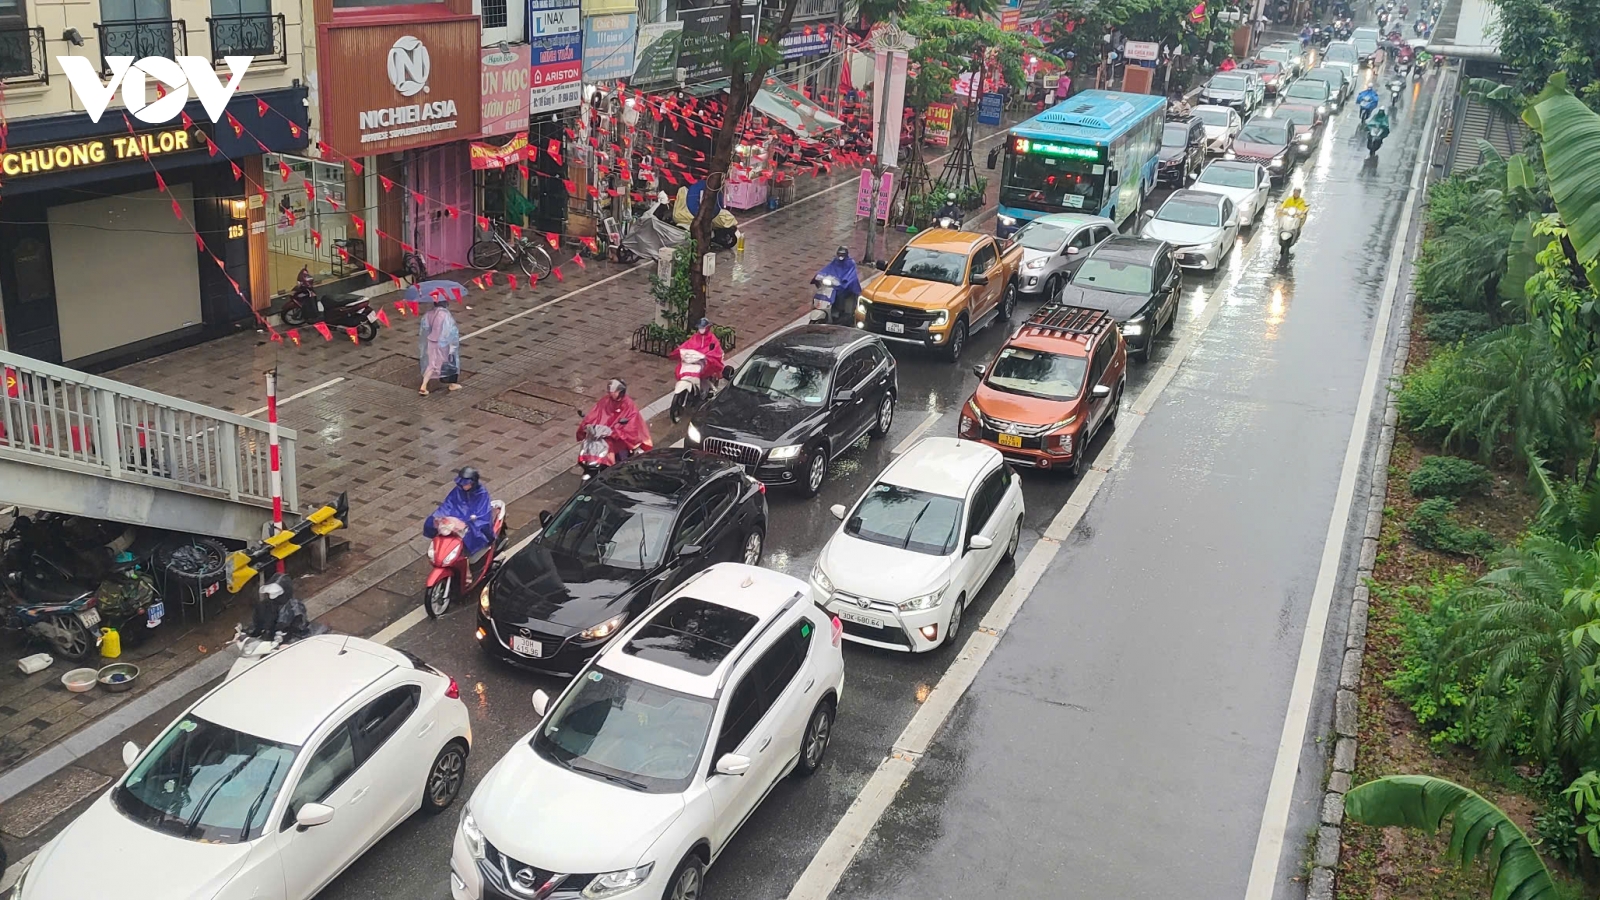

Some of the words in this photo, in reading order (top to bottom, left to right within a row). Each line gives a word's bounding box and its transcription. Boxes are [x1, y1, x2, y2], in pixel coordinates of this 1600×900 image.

[544, 12, 564, 25] INAX
[545, 69, 579, 82] ARISTON
[359, 105, 420, 130] NICHIEI
[421, 100, 458, 120] ASIA
[481, 99, 503, 119] ƯỜN
[3, 141, 105, 176] CHUONG
[113, 130, 189, 160] TAILOR
[228, 225, 244, 239] 105
[843, 612, 880, 627] 30K-680.64
[516, 645, 539, 656] 415.96
[521, 639, 534, 648] 30H
